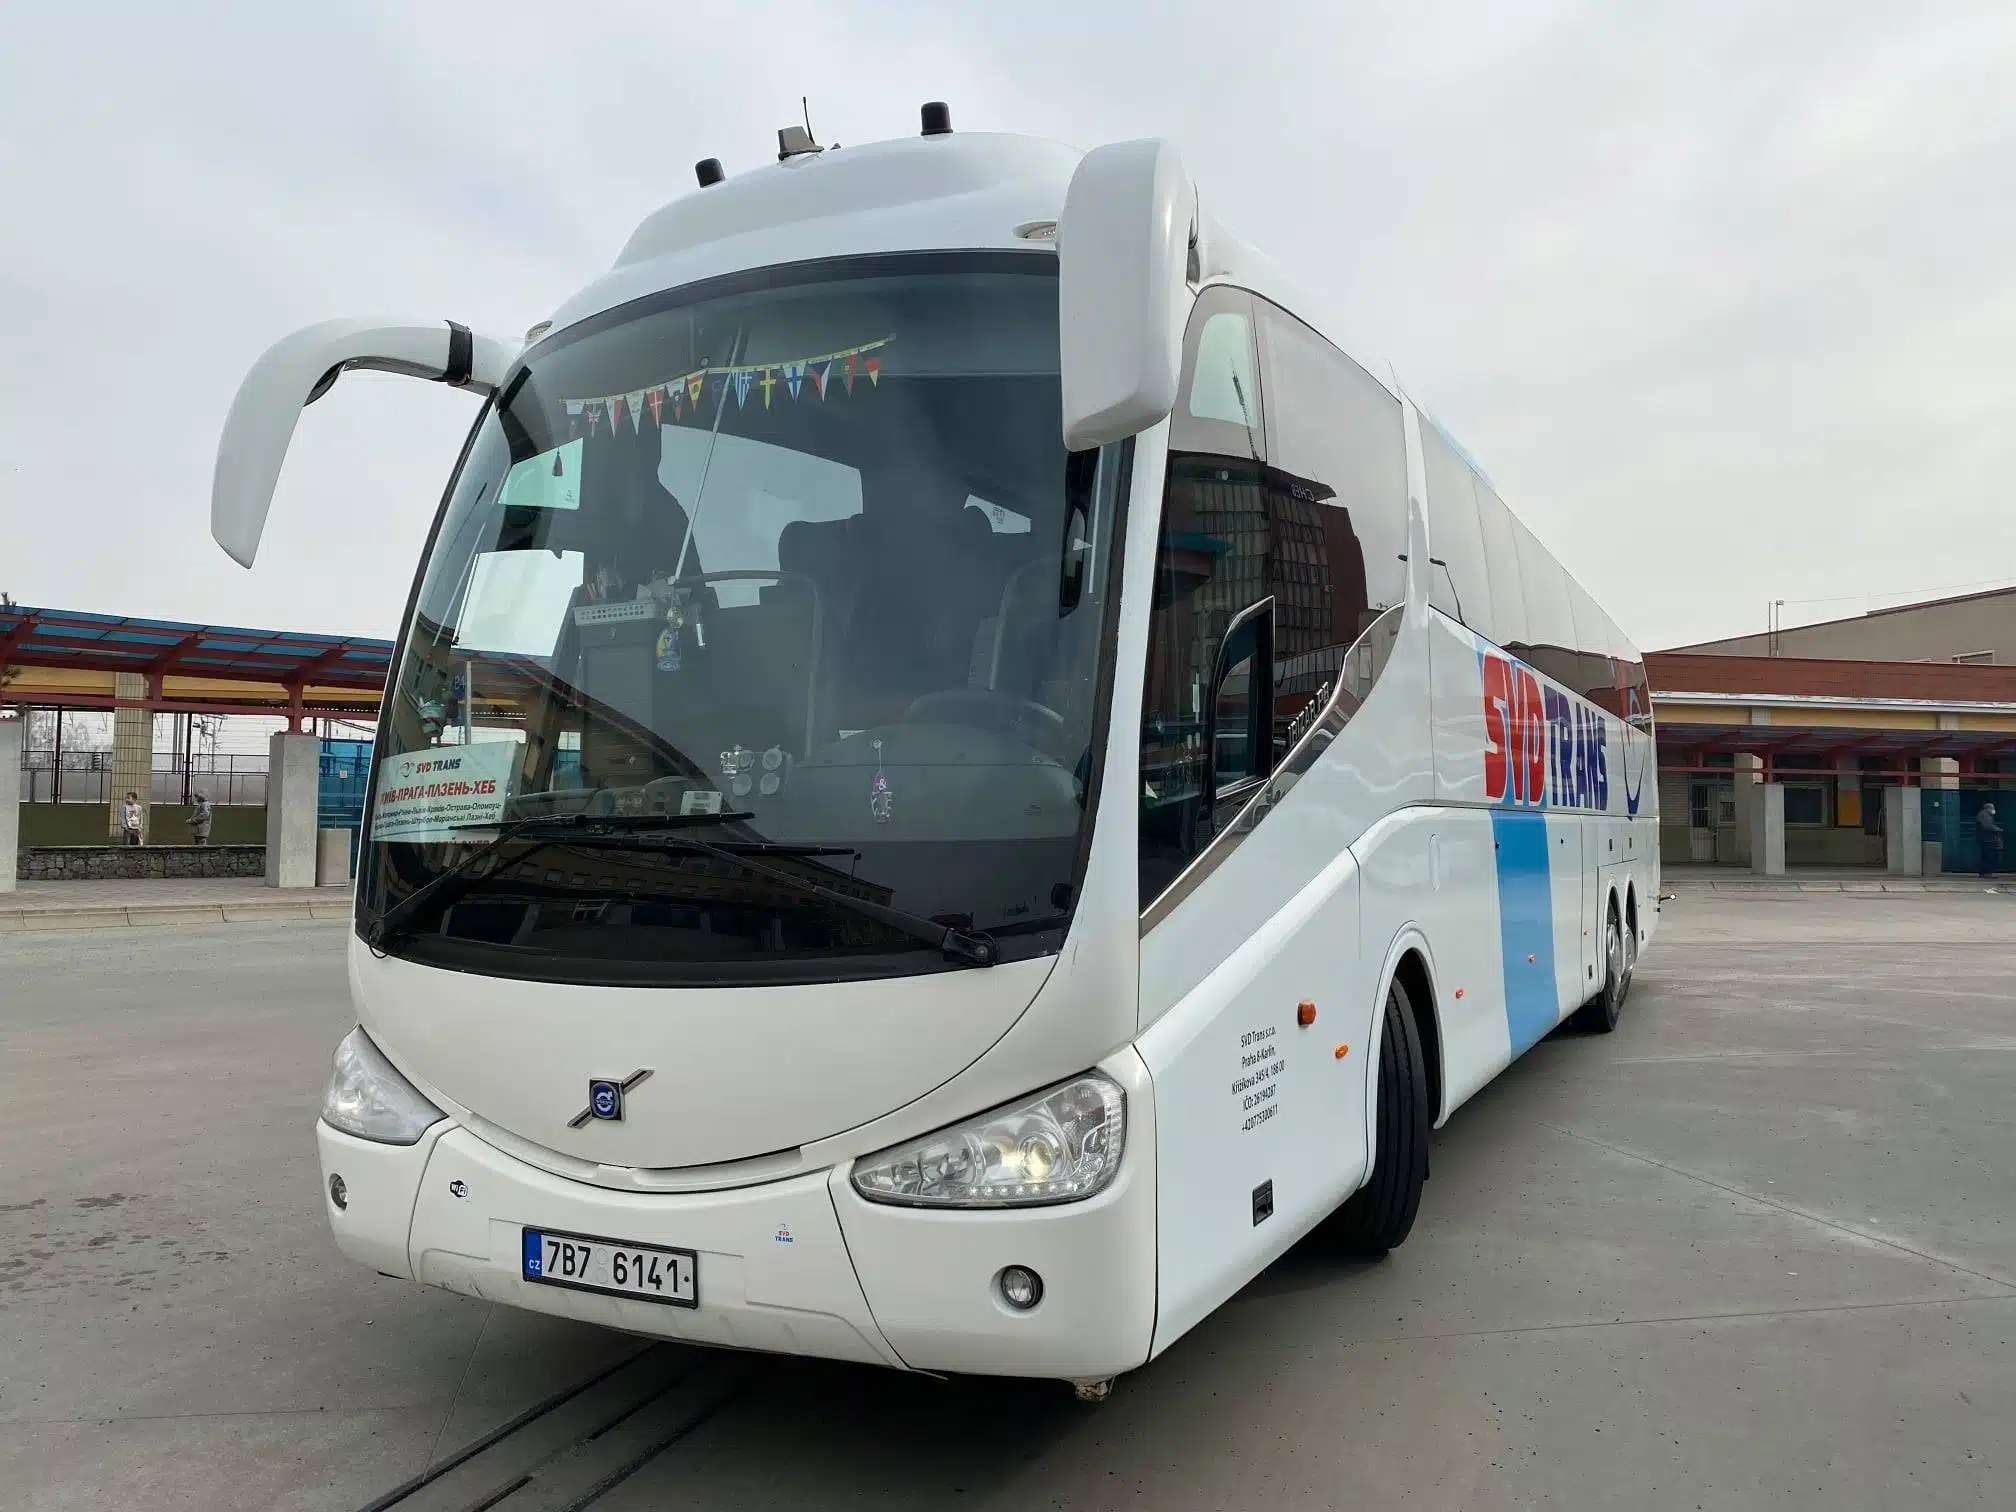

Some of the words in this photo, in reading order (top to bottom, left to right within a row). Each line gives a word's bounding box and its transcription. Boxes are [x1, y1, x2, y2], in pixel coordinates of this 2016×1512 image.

[1287, 699, 1317, 748] IRIZAR
[1483, 652, 1546, 806] SVD
[1543, 684, 1608, 811] TRANS
[416, 762, 432, 774] SVD
[432, 758, 462, 772] TRANS
[1241, 1032, 1252, 1048] SVD
[1251, 1030, 1266, 1043] Trans
[1241, 1052, 1257, 1069] Praha
[775, 1235, 794, 1243] TRANS
[528, 1259, 541, 1271] CZ
[547, 1240, 592, 1279] 7B7
[612, 1251, 679, 1293] 6141
